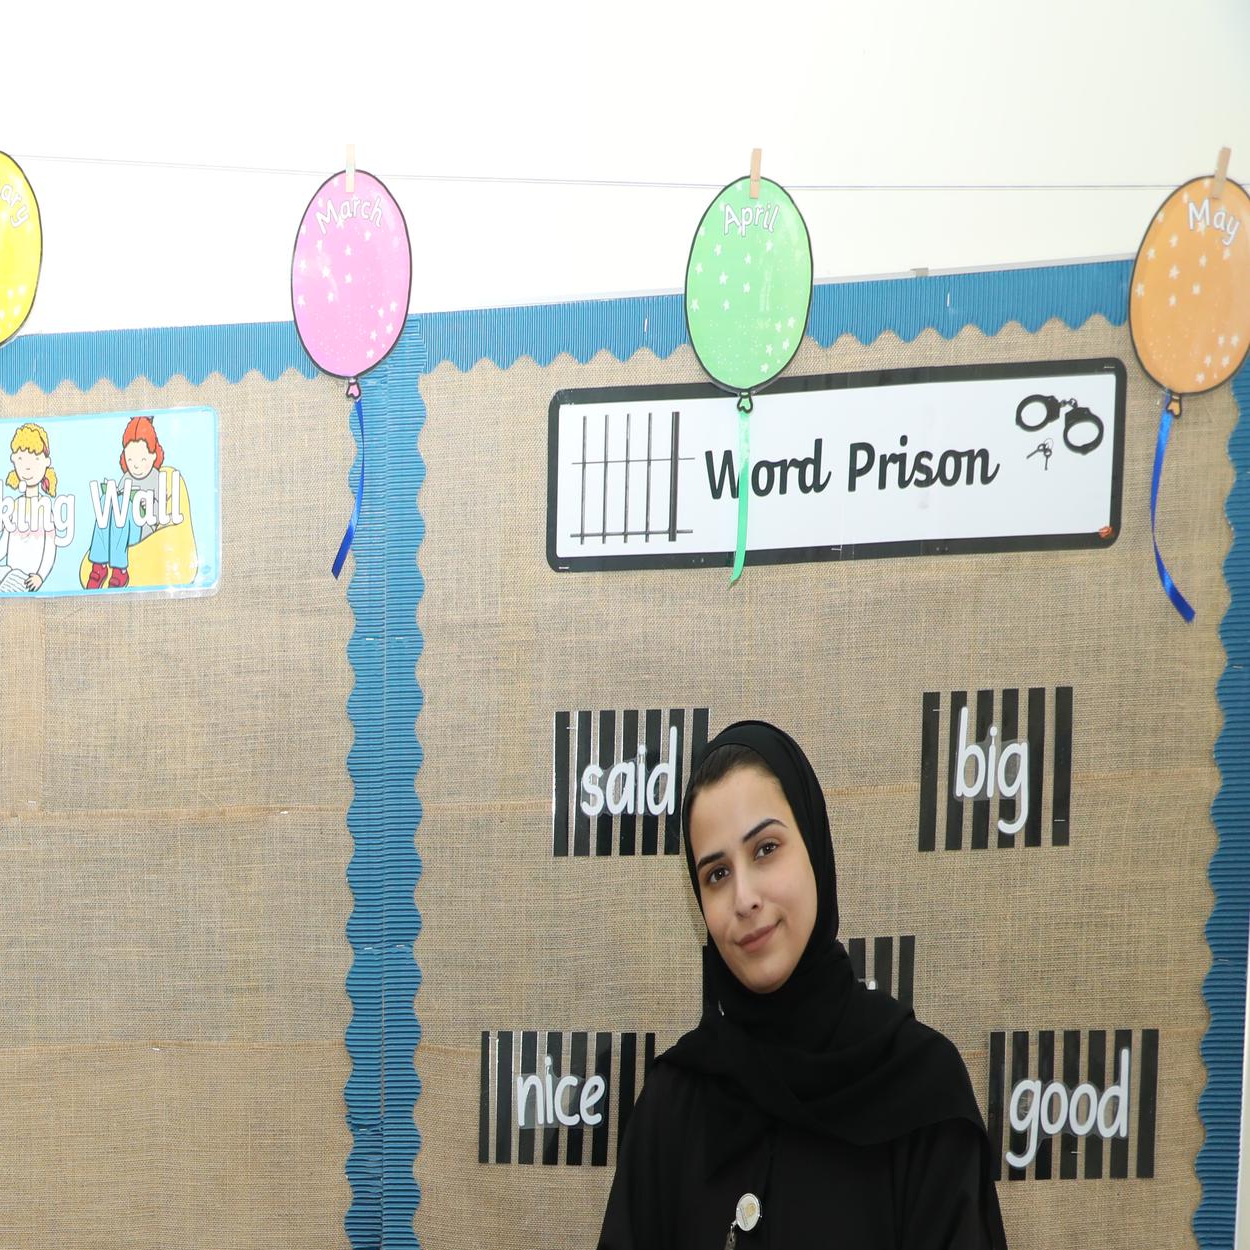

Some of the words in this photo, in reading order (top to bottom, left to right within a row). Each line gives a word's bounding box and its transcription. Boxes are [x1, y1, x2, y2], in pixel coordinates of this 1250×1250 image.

[315, 196, 383, 235] March
[724, 203, 780, 236] April
[1188, 199, 1240, 246] May
[705, 438, 832, 499] Word
[847, 434, 1000, 493] Prison
[89, 471, 184, 528] Wall
[580, 725, 678, 817] said
[955, 707, 1030, 834] big
[516, 1056, 607, 1127] nice
[1005, 1048, 1130, 1168] good
